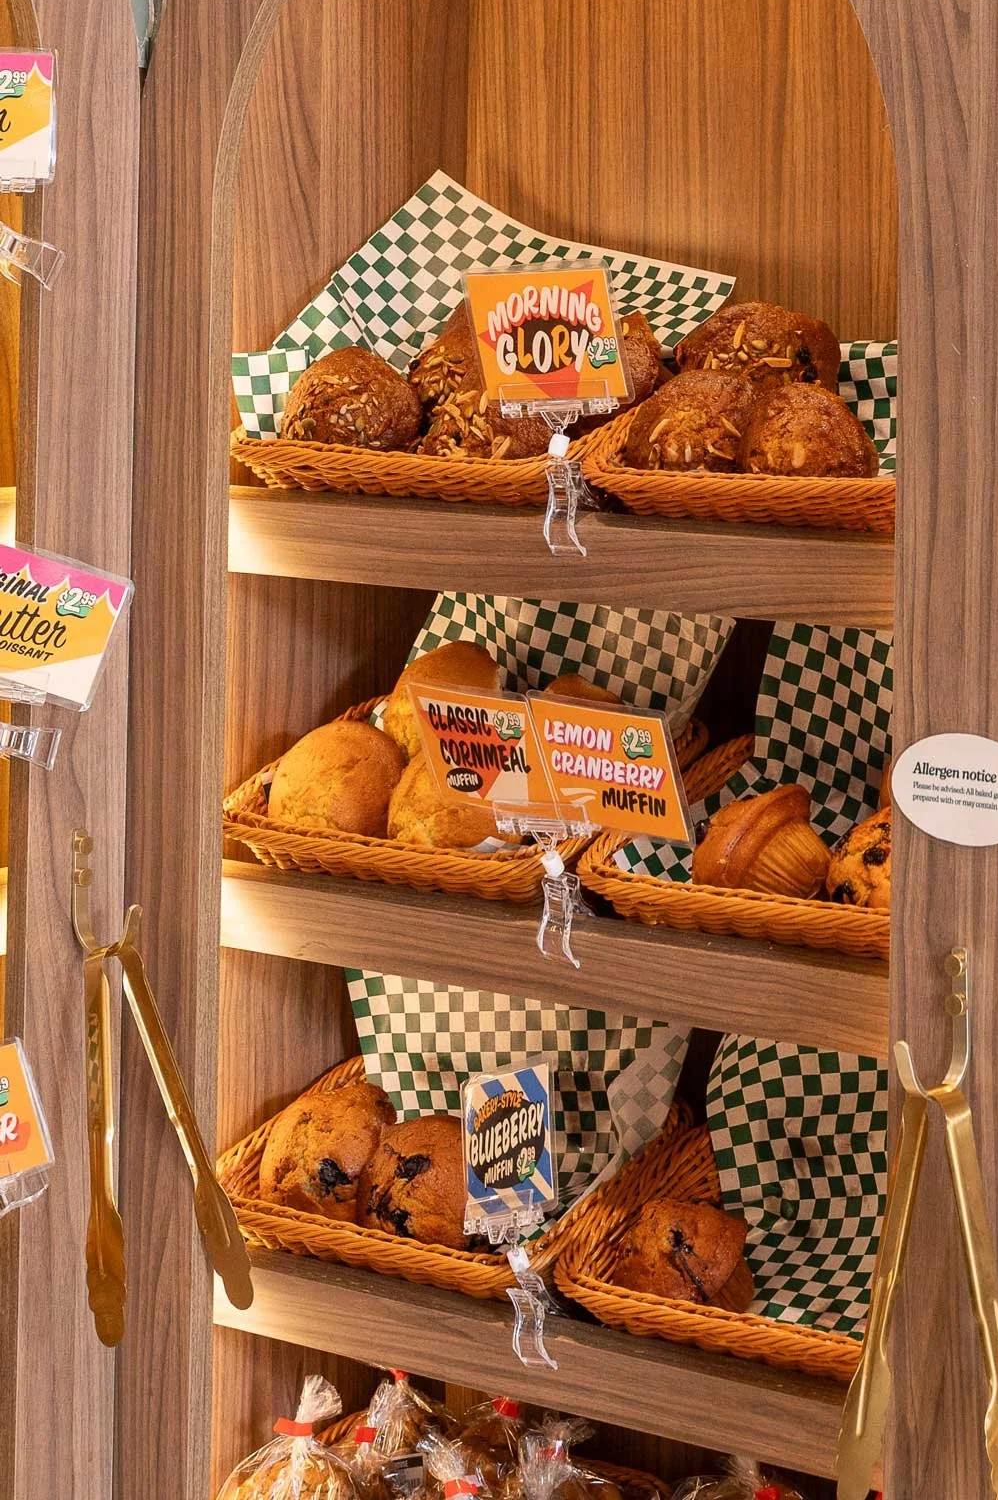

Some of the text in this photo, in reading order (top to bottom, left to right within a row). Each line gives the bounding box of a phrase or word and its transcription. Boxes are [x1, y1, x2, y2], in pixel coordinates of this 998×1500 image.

[487, 284, 603, 342] MORNING
[496, 324, 589, 375] GLORY
[428, 702, 492, 736] CLASSIC
[544, 719, 613, 752] LEMON
[439, 737, 531, 774] CORNMEAL
[551, 749, 665, 790] CRANBERRY
[912, 761, 997, 783] Allergen notice
[447, 771, 479, 789] MUFFIN
[601, 787, 667, 818] MUFFIN
[474, 1090, 524, 1132] BAKERY-STYLE
[470, 1102, 544, 1167] BLUEBERRY
[484, 1157, 514, 1189] MUFFIN
